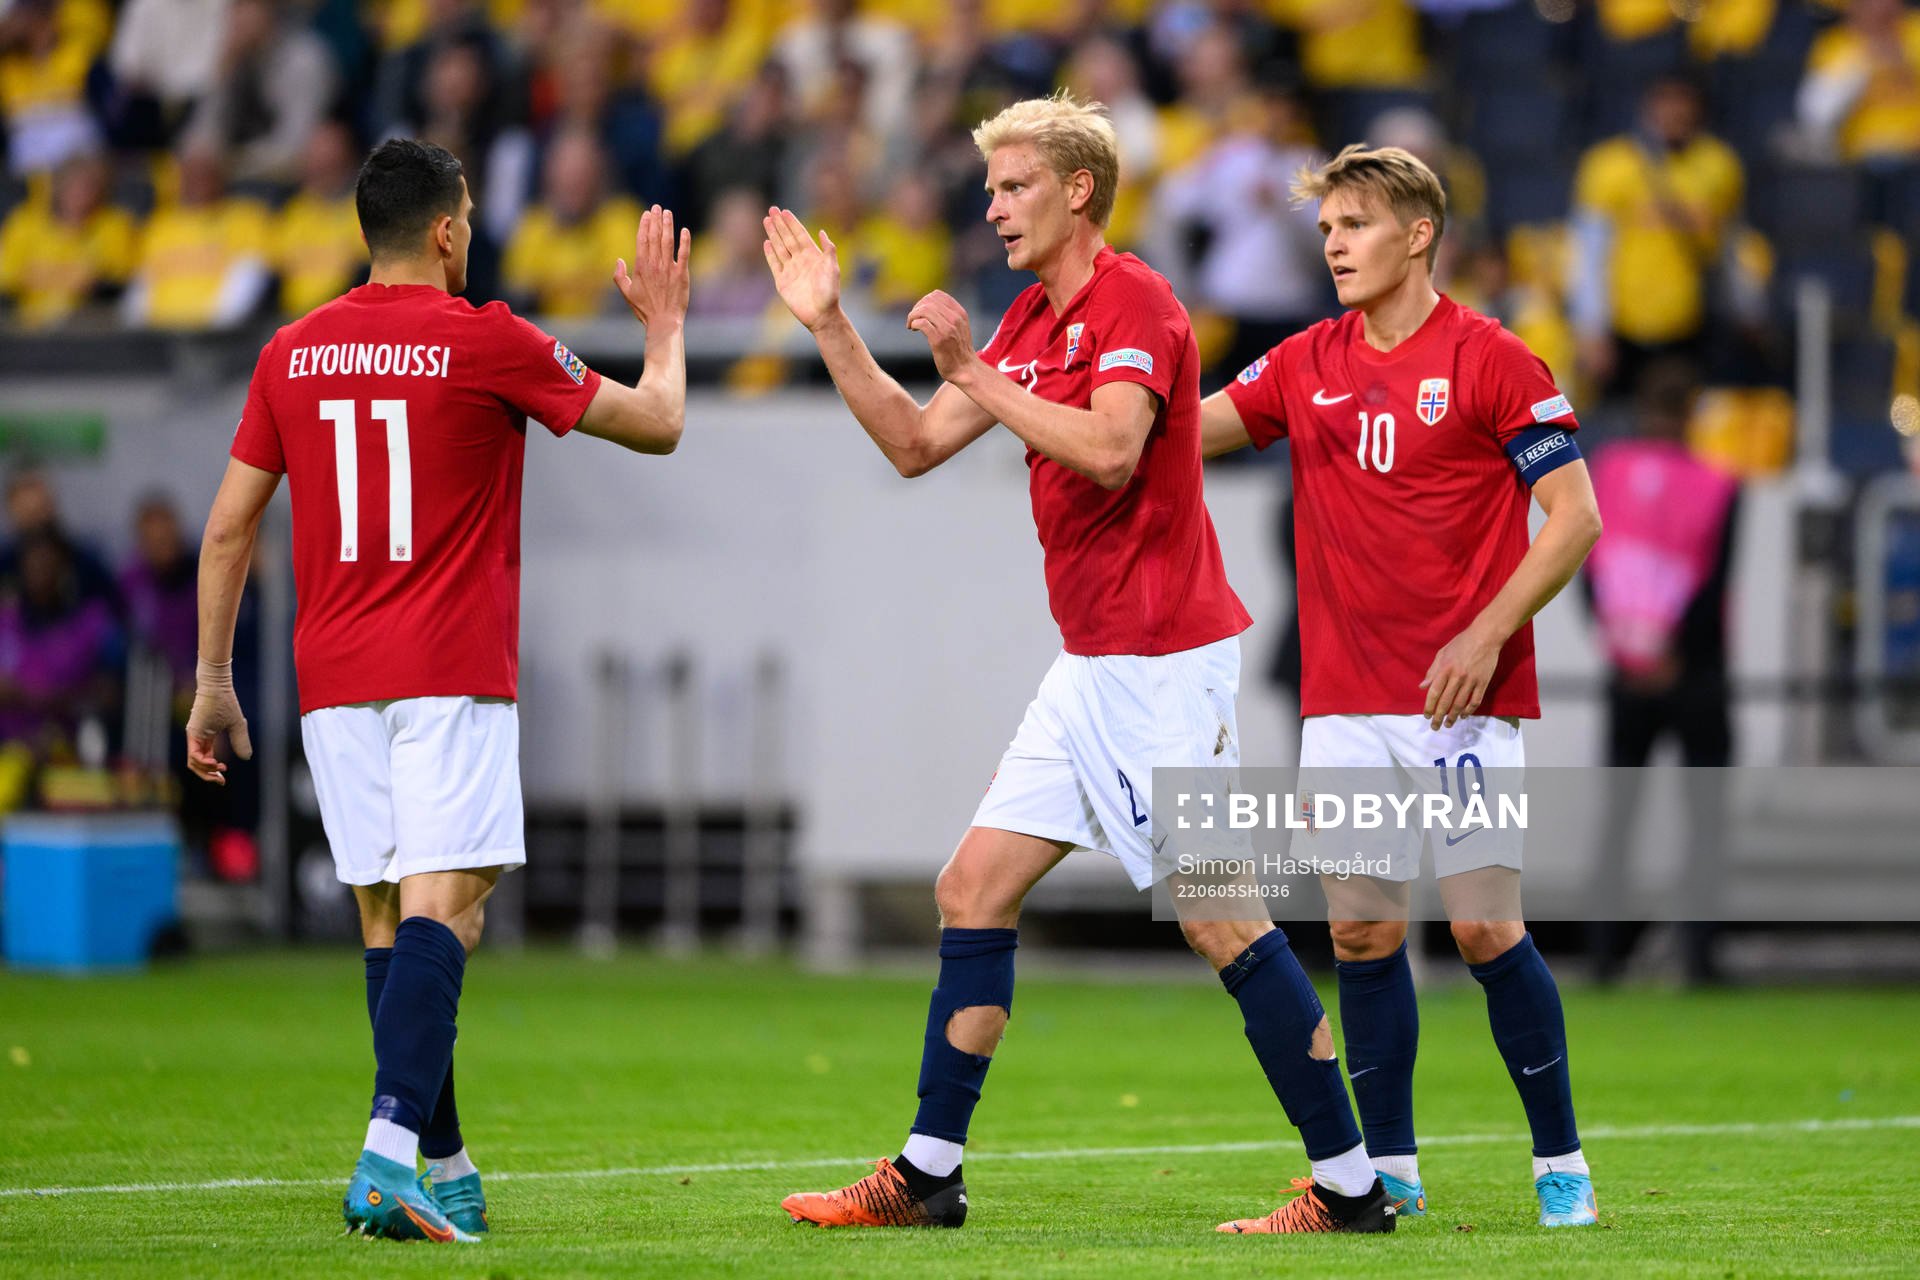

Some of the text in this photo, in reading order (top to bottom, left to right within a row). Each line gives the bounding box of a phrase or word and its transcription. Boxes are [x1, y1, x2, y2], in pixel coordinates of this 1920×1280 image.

[288, 343, 450, 378] ELYOUNOUSSI
[1101, 354, 1152, 368] FOUNDATION
[1357, 411, 1395, 473] 10
[1526, 434, 1567, 462] RESPECT
[319, 399, 412, 562] 11
[1117, 768, 1148, 827] 2
[1434, 753, 1486, 815] 10
